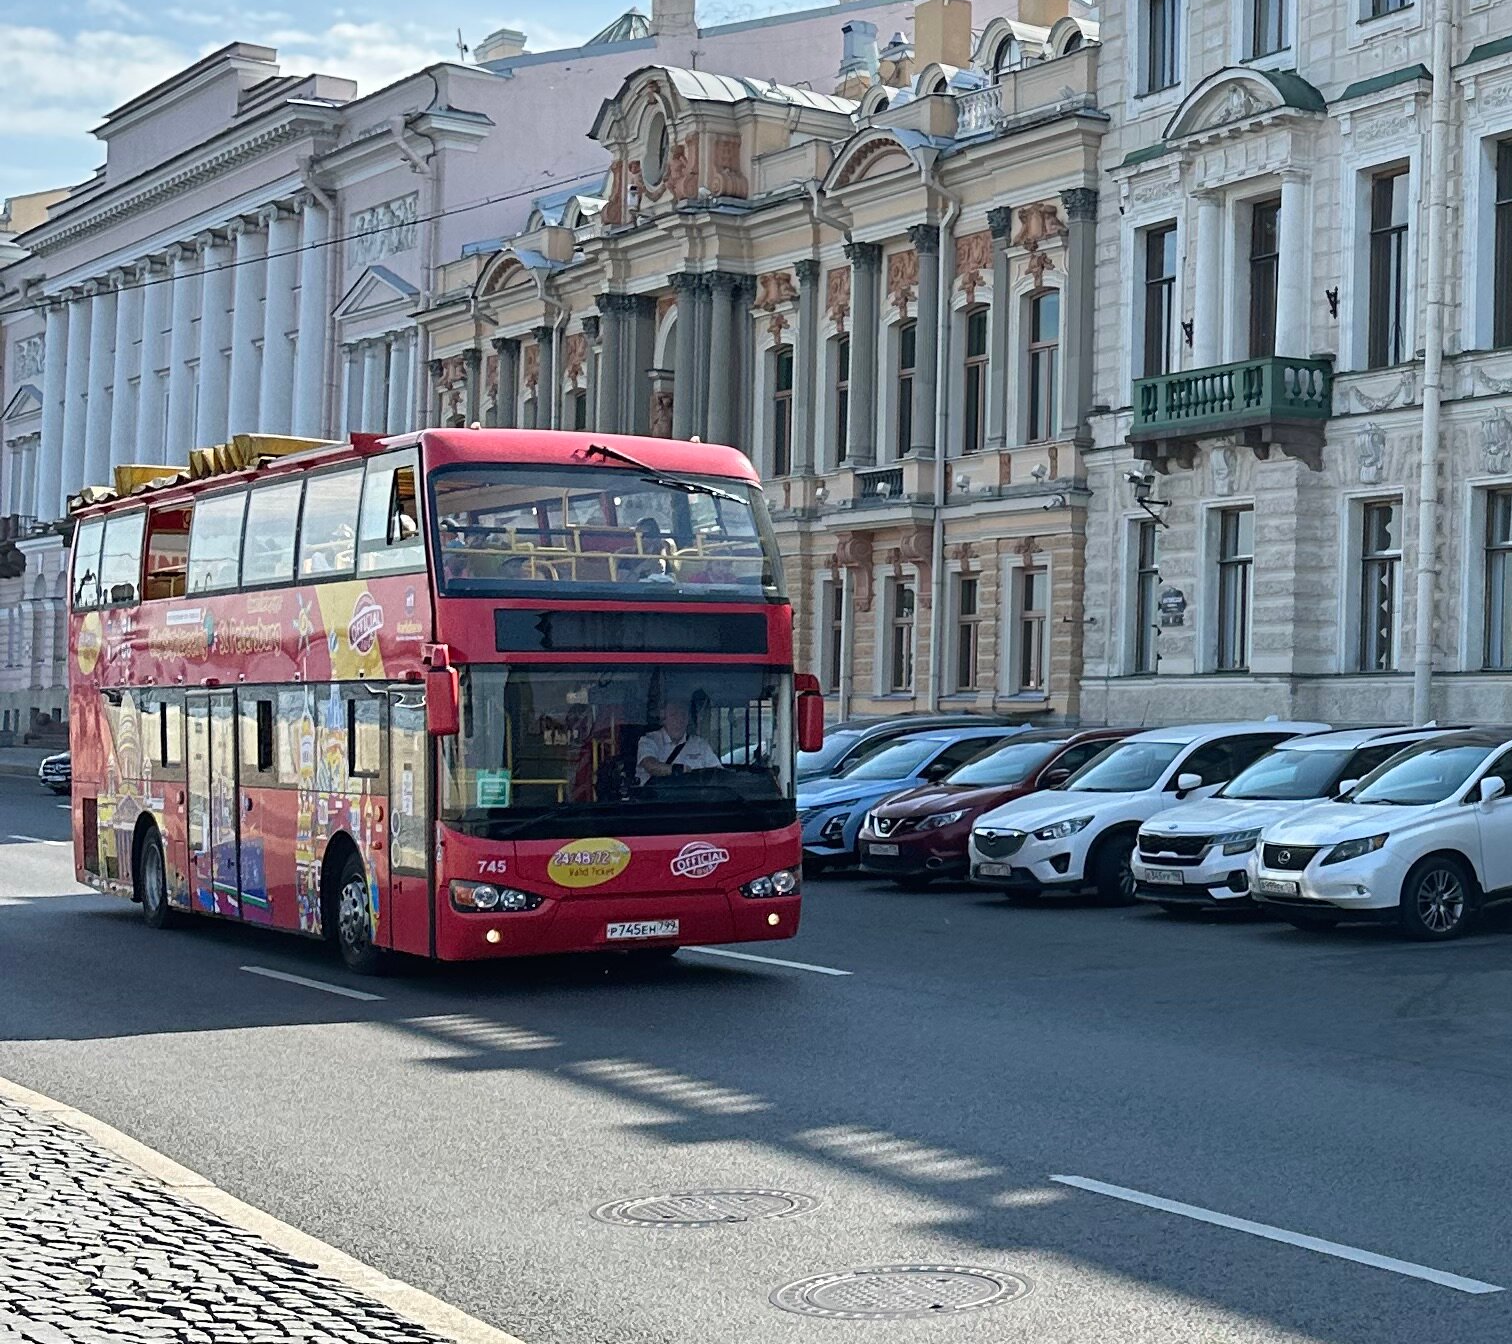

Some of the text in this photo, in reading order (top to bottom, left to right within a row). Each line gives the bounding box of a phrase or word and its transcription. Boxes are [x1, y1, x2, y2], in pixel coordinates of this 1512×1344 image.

[477, 860, 507, 873] 745
[677, 852, 724, 871] OFFICIAL
[658, 920, 676, 930] 799
